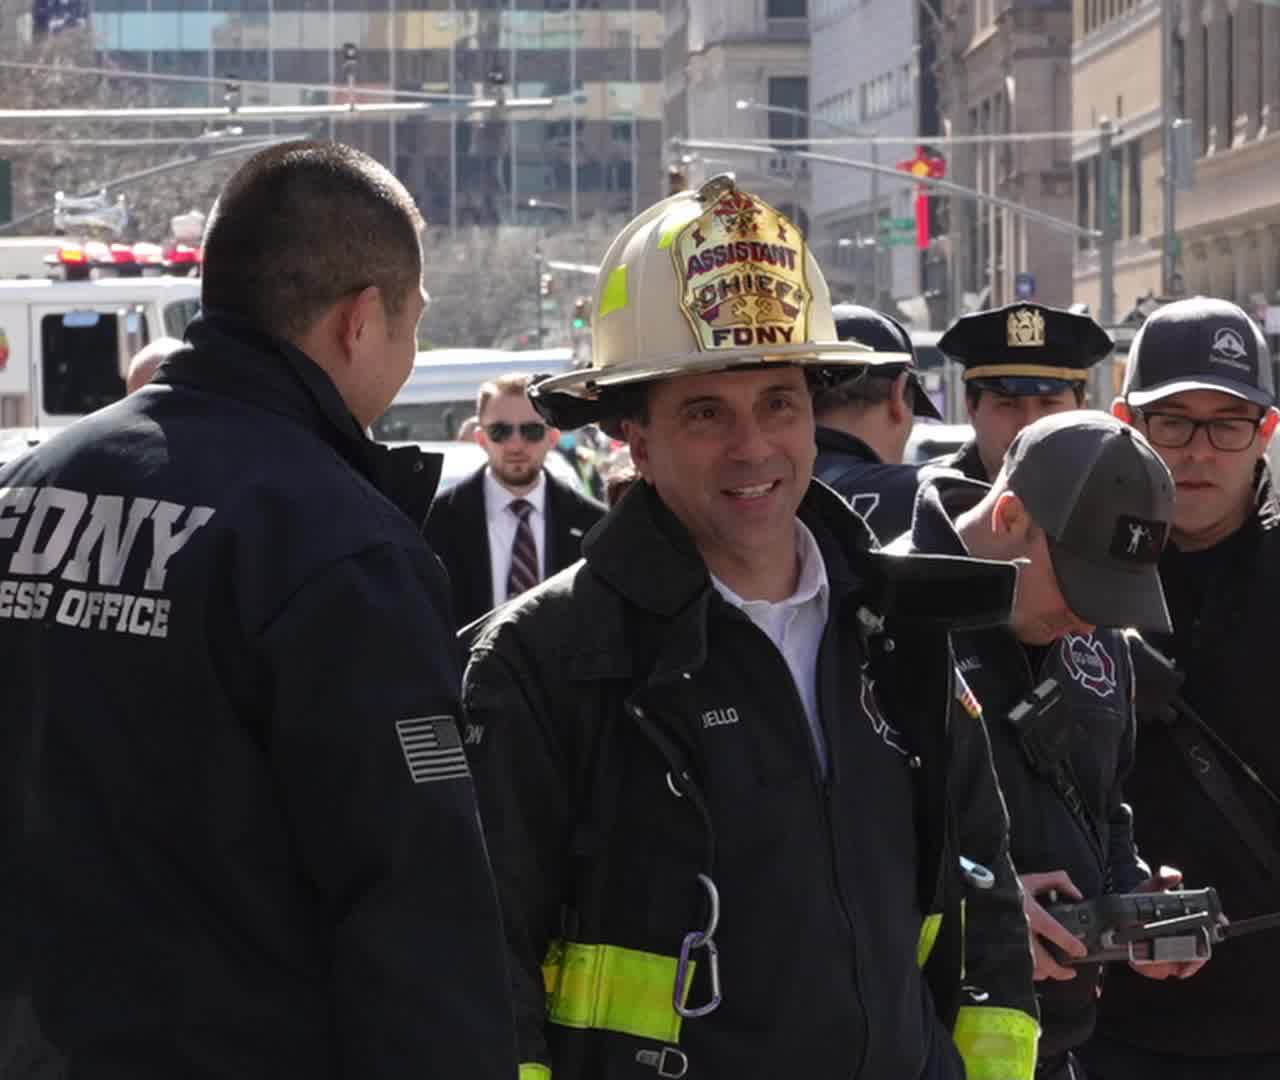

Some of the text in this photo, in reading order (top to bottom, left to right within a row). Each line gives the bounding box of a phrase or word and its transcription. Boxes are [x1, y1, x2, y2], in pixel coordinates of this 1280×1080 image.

[687, 241, 798, 280] ASSISTANT
[699, 272, 793, 312] CHIEF
[712, 326, 795, 346] FDNY
[56, 589, 171, 638] OFFICE
